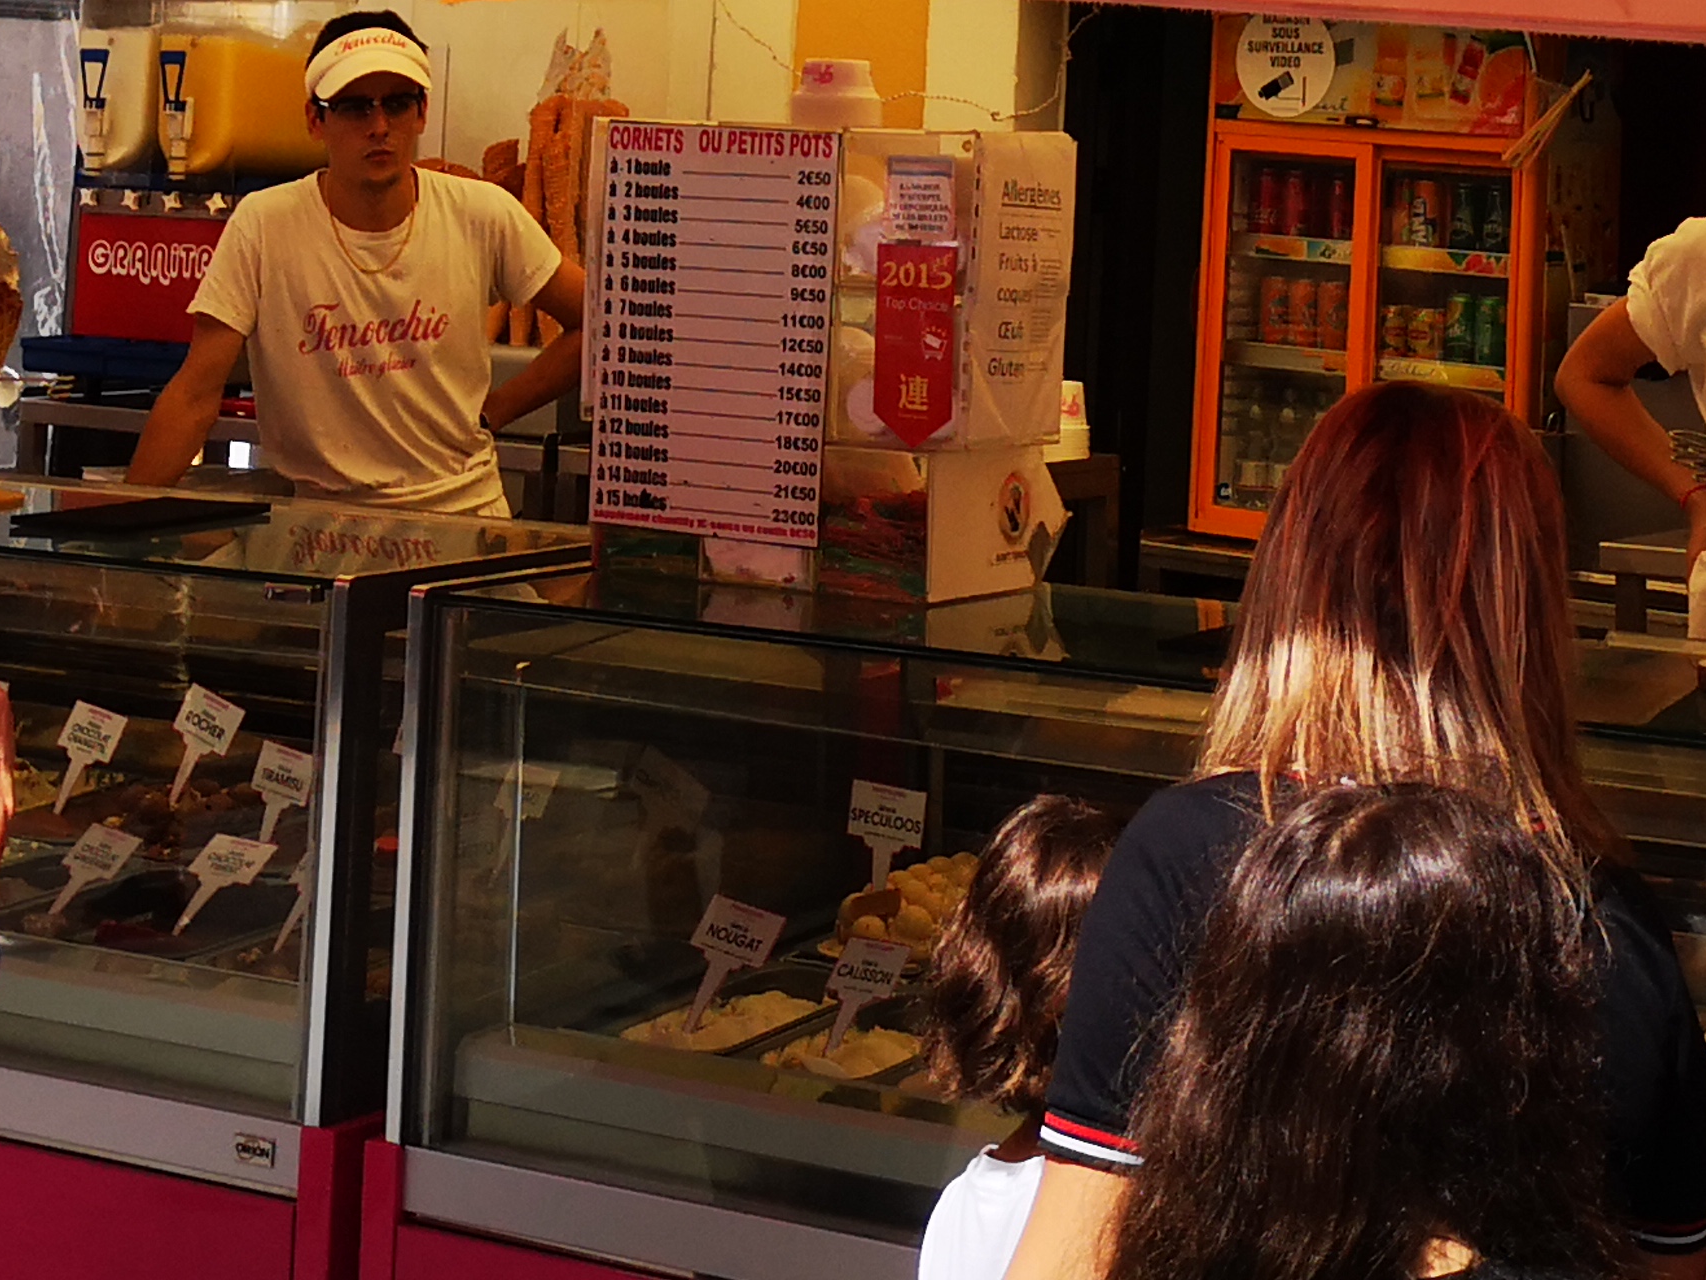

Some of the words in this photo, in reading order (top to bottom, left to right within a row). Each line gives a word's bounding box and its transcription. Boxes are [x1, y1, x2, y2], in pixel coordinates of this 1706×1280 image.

[1248, 40, 1324, 55] SURVEILLANCE
[1271, 27, 1300, 39] SOUS
[610, 126, 684, 154] CORNETS
[699, 129, 722, 153] OU
[727, 131, 784, 157] PETITS
[790, 134, 833, 158] POTS
[626, 159, 632, 174] 1
[635, 159, 671, 176] boule
[798, 171, 830, 186] 2€50
[625, 182, 633, 197] 2
[635, 182, 678, 200] boules
[796, 195, 830, 210] 4€00
[1001, 180, 1062, 205] Allergènes
[623, 205, 632, 221] 3
[635, 206, 678, 223] boules
[795, 219, 828, 234] 5€50
[1000, 223, 1038, 241] Lactose
[622, 229, 630, 244] 4
[633, 229, 676, 247] boules
[792, 241, 827, 256] 6€50
[621, 252, 629, 268] 5
[633, 253, 676, 271] boules
[791, 265, 826, 279] 8€00
[999, 254, 1029, 273] Fruits
[621, 276, 629, 291] 6
[632, 276, 675, 294] boules
[790, 288, 825, 302] 9€50
[298, 299, 449, 354] Fenocchio
[620, 299, 627, 314] 7
[629, 300, 672, 318] boules
[781, 314, 824, 329] 11€00
[618, 323, 626, 338] 8
[629, 323, 673, 342] boules
[780, 338, 823, 353] 12€50
[618, 346, 626, 362] 9
[629, 347, 672, 366] boules
[779, 363, 822, 378] 14€00
[611, 370, 625, 386] 10
[628, 372, 671, 390] boules
[778, 387, 821, 403] 15€50
[611, 394, 622, 410] 11
[625, 395, 668, 414] boules
[776, 411, 819, 427] 17€00
[610, 418, 623, 434] 12
[625, 419, 668, 438] boules
[775, 436, 818, 452] 18€50
[608, 442, 622, 458] 13
[625, 443, 668, 462] boules
[773, 460, 817, 477] 20€00
[607, 466, 621, 482] 14
[623, 467, 667, 486] boules
[773, 485, 816, 501] 21€50
[607, 490, 620, 506] 15
[771, 509, 815, 526] 23€00
[185, 710, 225, 739] ROCHER
[852, 808, 921, 834] SPECULOOS
[706, 924, 763, 952] NOUGAT
